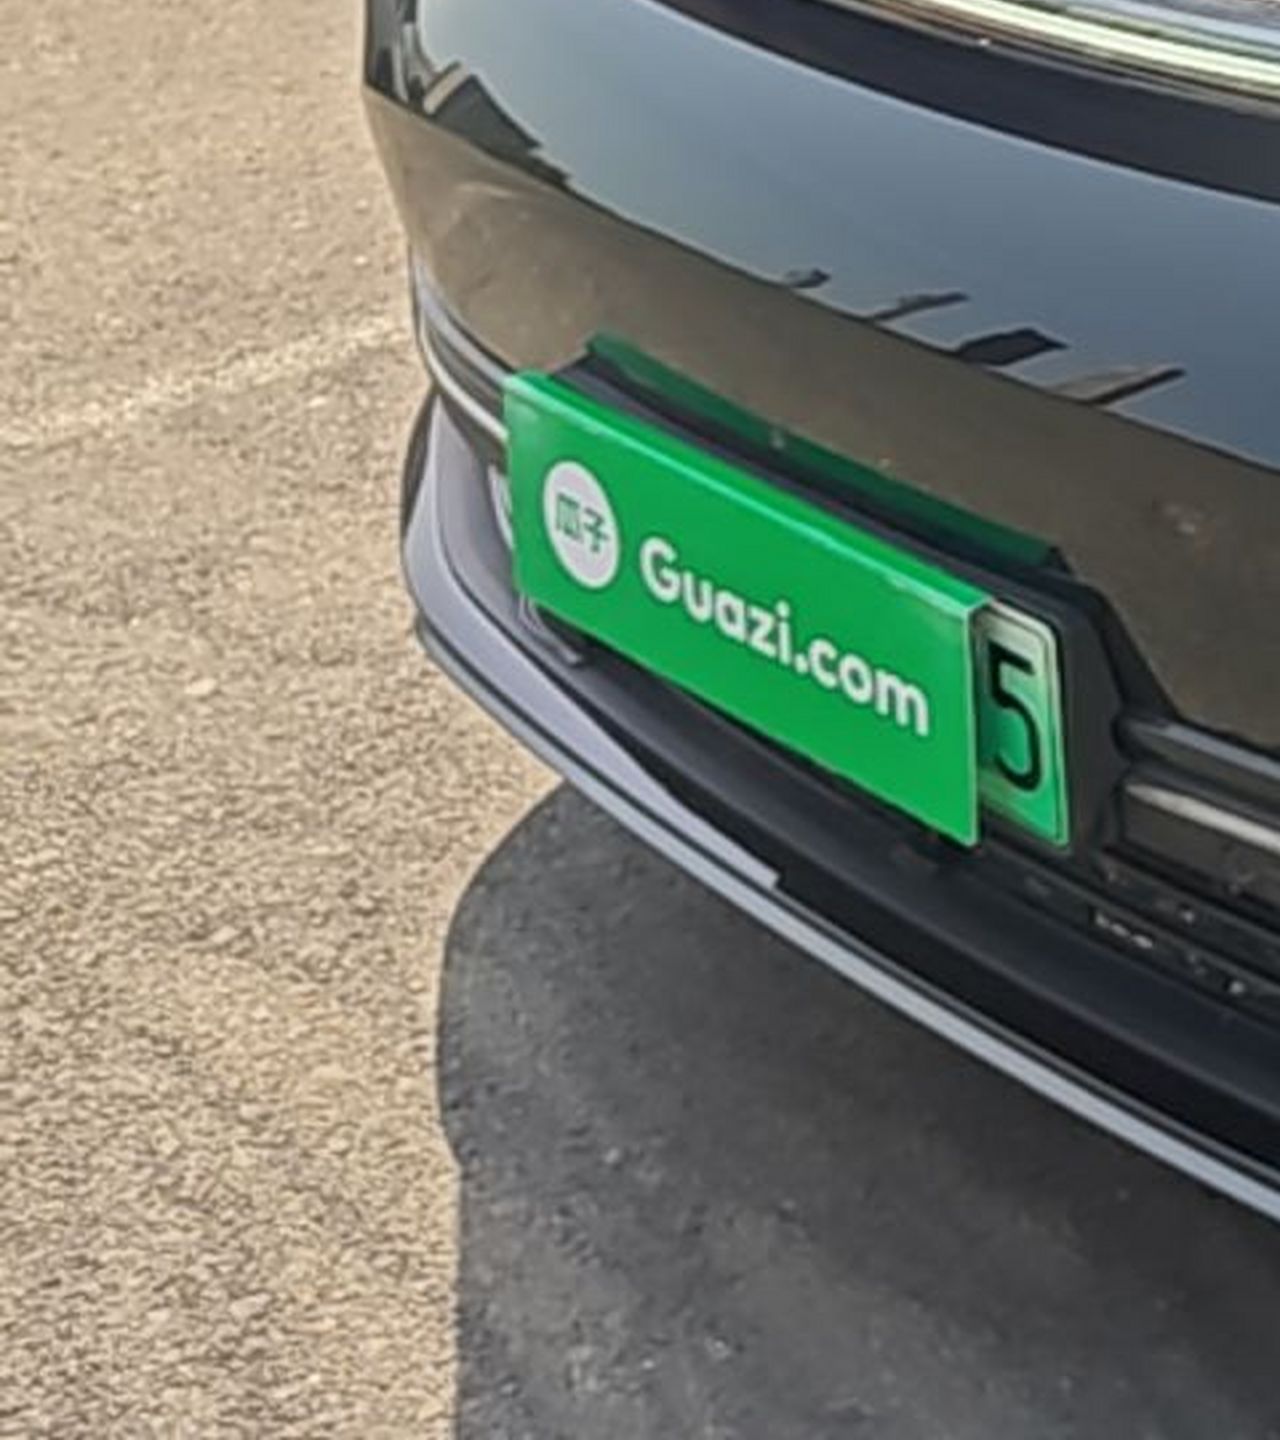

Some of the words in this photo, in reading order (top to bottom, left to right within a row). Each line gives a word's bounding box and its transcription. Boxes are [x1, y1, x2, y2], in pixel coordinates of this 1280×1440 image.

[556, 492, 610, 554] 瓜子
[639, 537, 930, 737] Guazi.com
[986, 639, 1042, 792] 5
